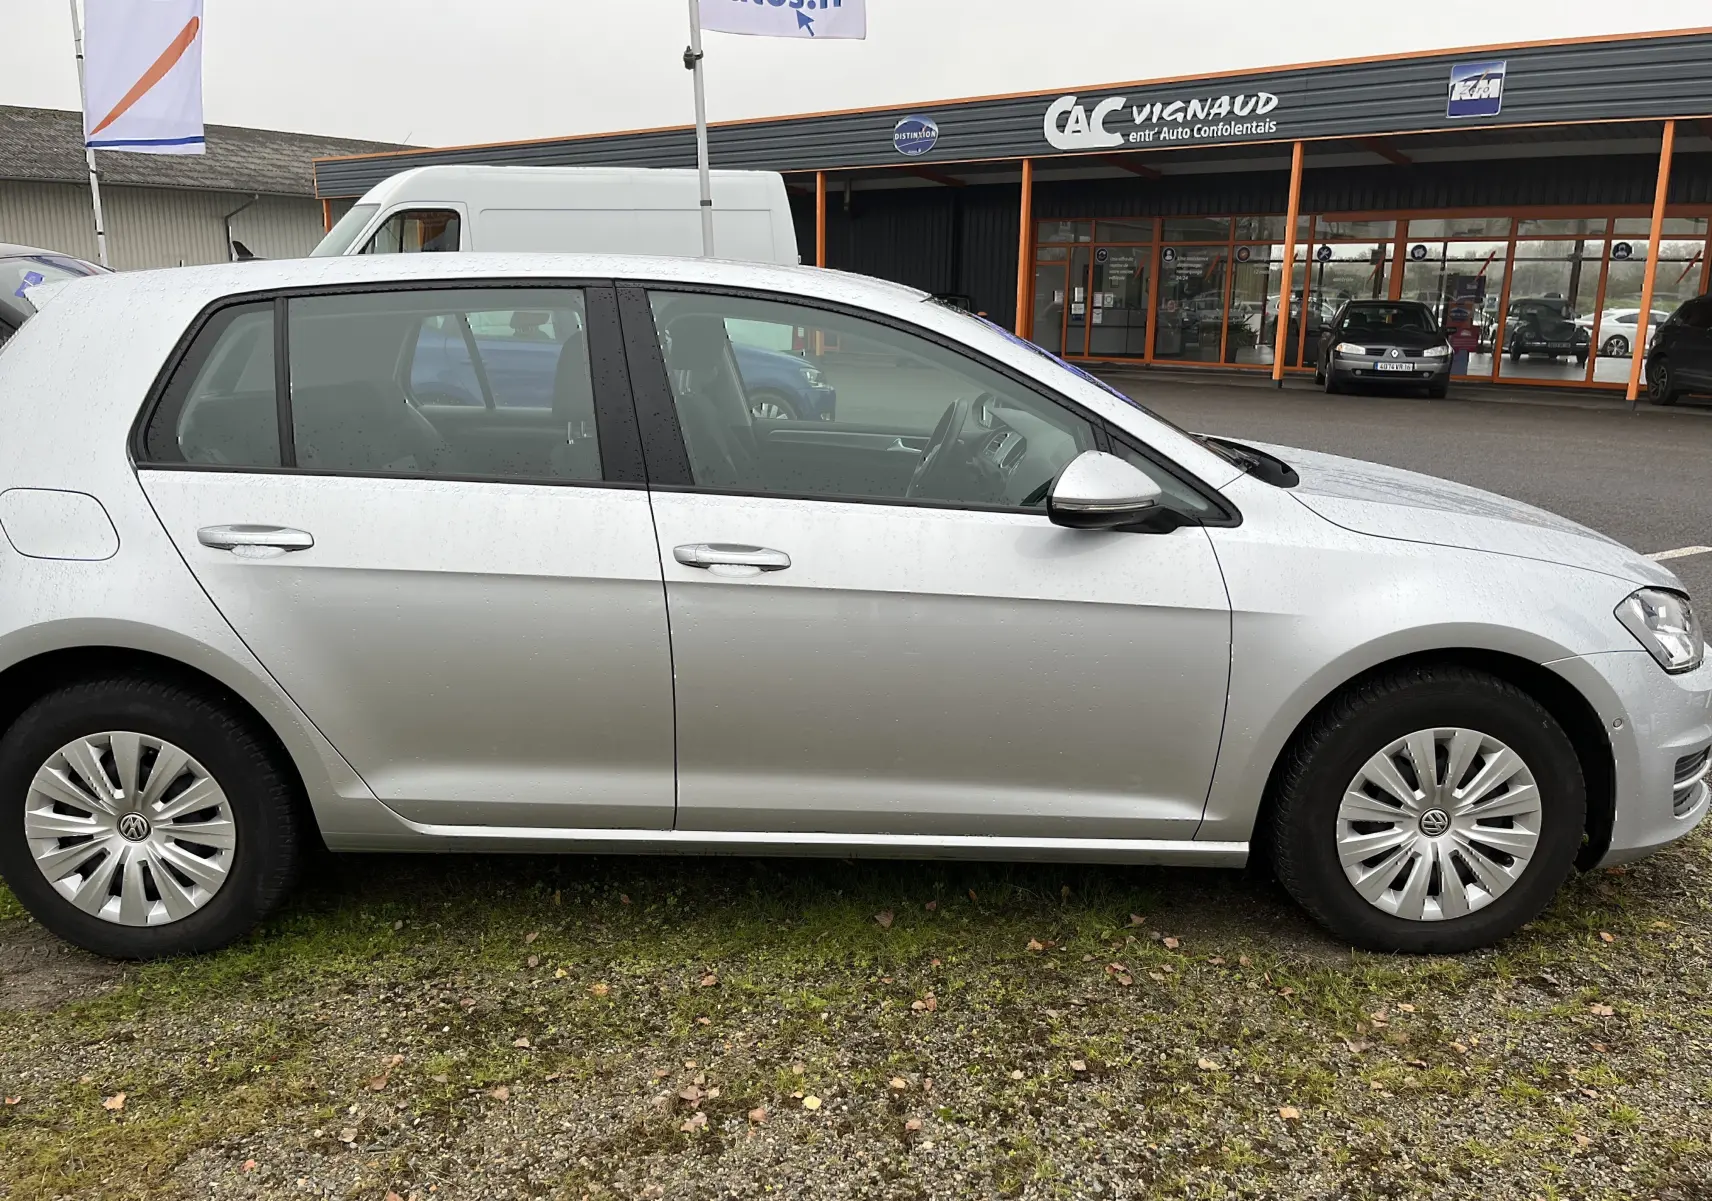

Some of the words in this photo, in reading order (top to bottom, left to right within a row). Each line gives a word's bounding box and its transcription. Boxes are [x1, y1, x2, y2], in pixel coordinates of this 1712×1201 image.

[1043, 95, 1127, 150] CAC
[1132, 92, 1279, 125] VIGNAUD
[1160, 125, 1190, 141] Auto
[1193, 118, 1277, 138] Confolentais
[894, 130, 936, 140] DISTINXION
